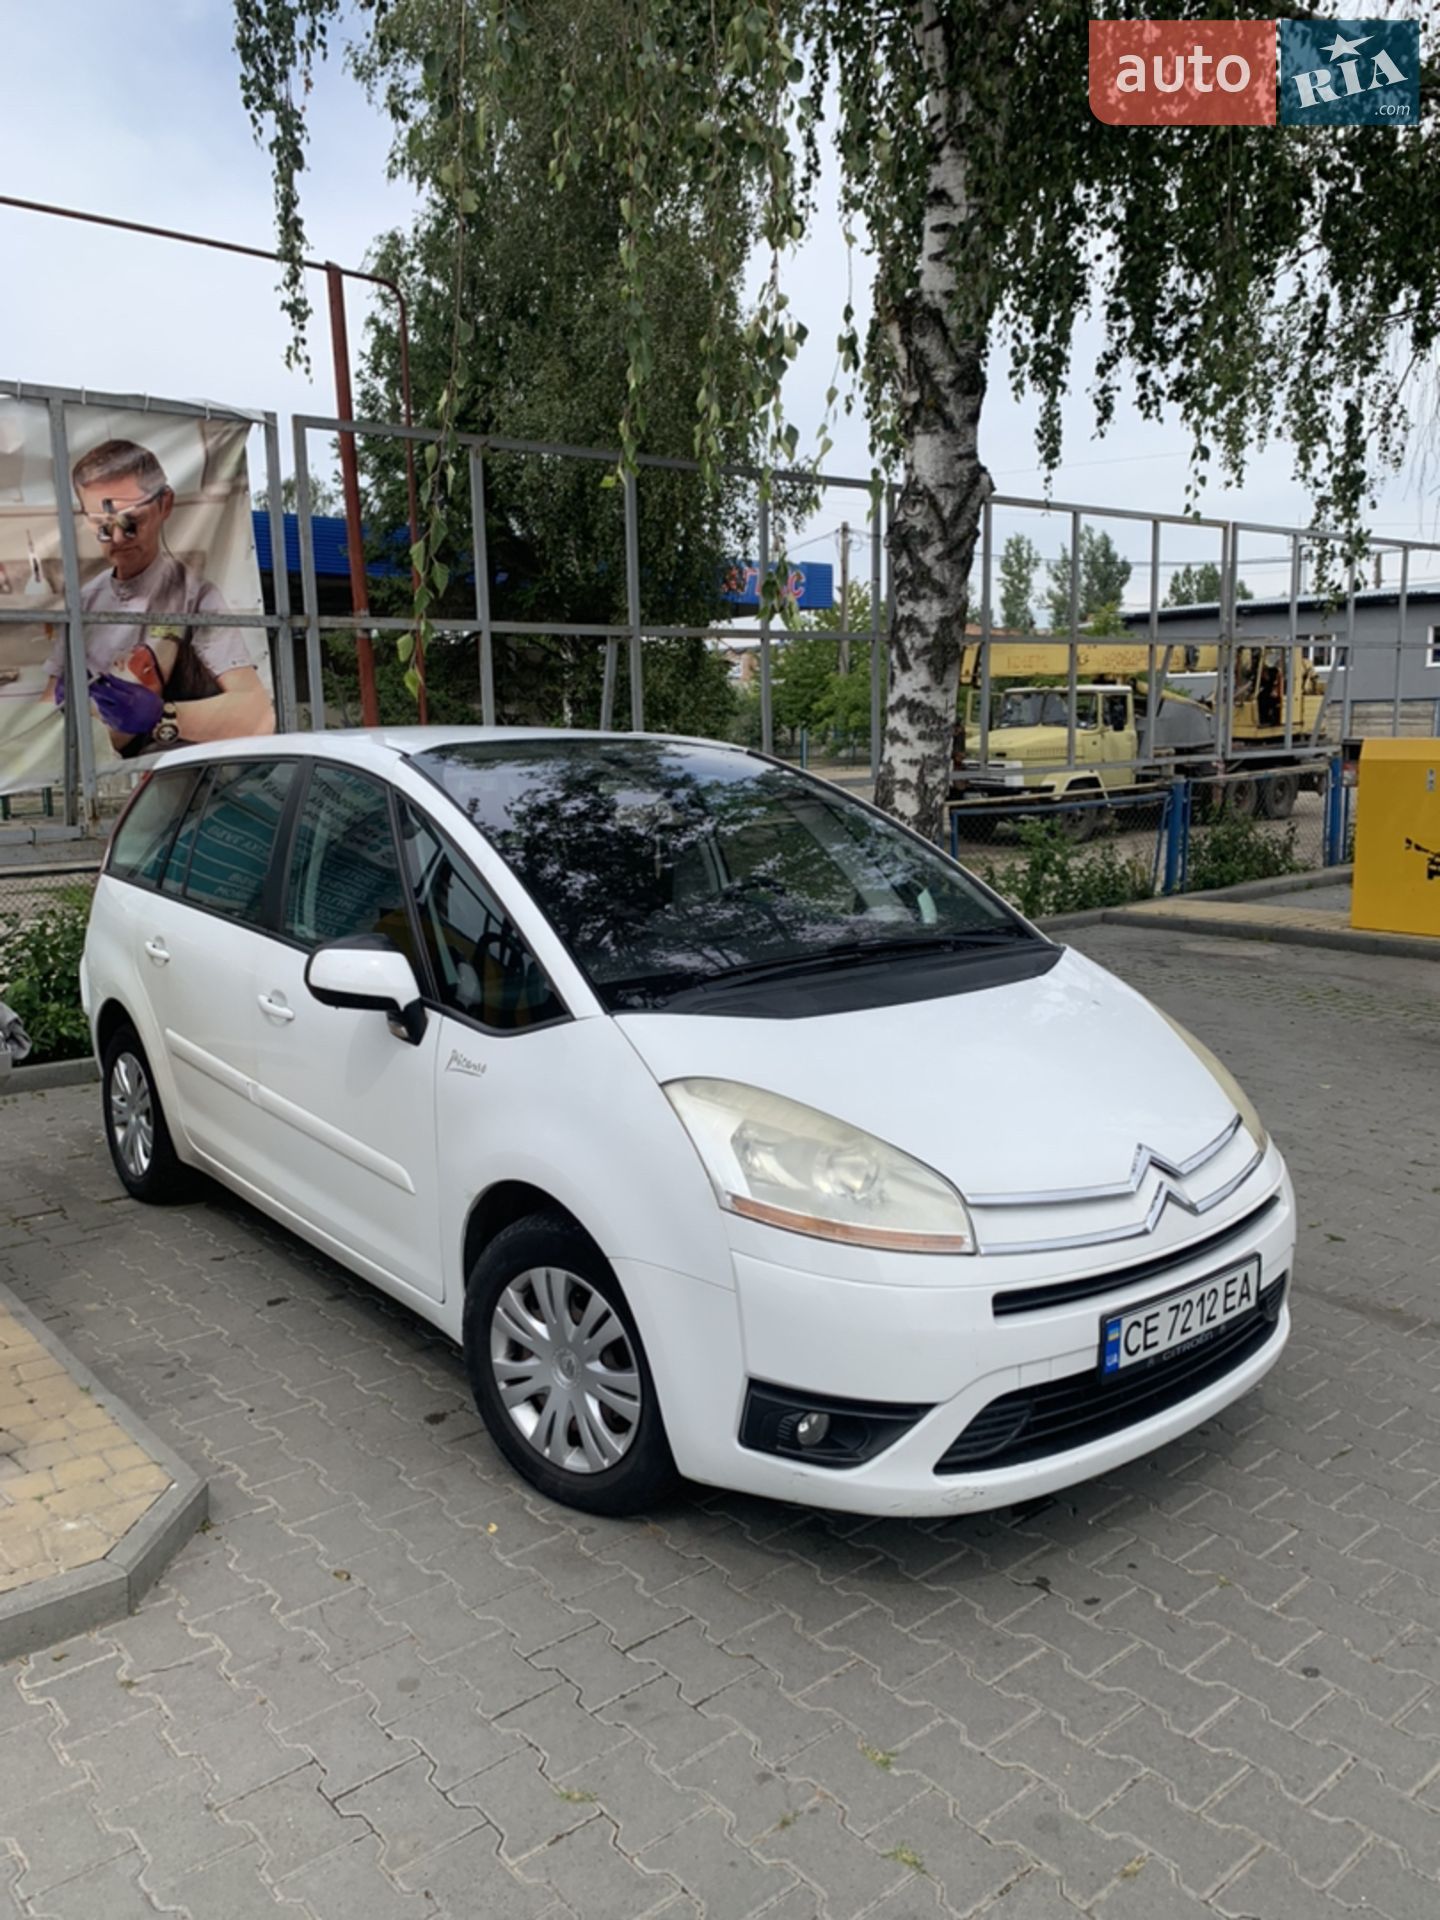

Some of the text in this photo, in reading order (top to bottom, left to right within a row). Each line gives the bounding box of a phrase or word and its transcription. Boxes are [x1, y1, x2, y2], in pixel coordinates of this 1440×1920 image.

[1123, 1272, 1251, 1357] CE 7212 EA
